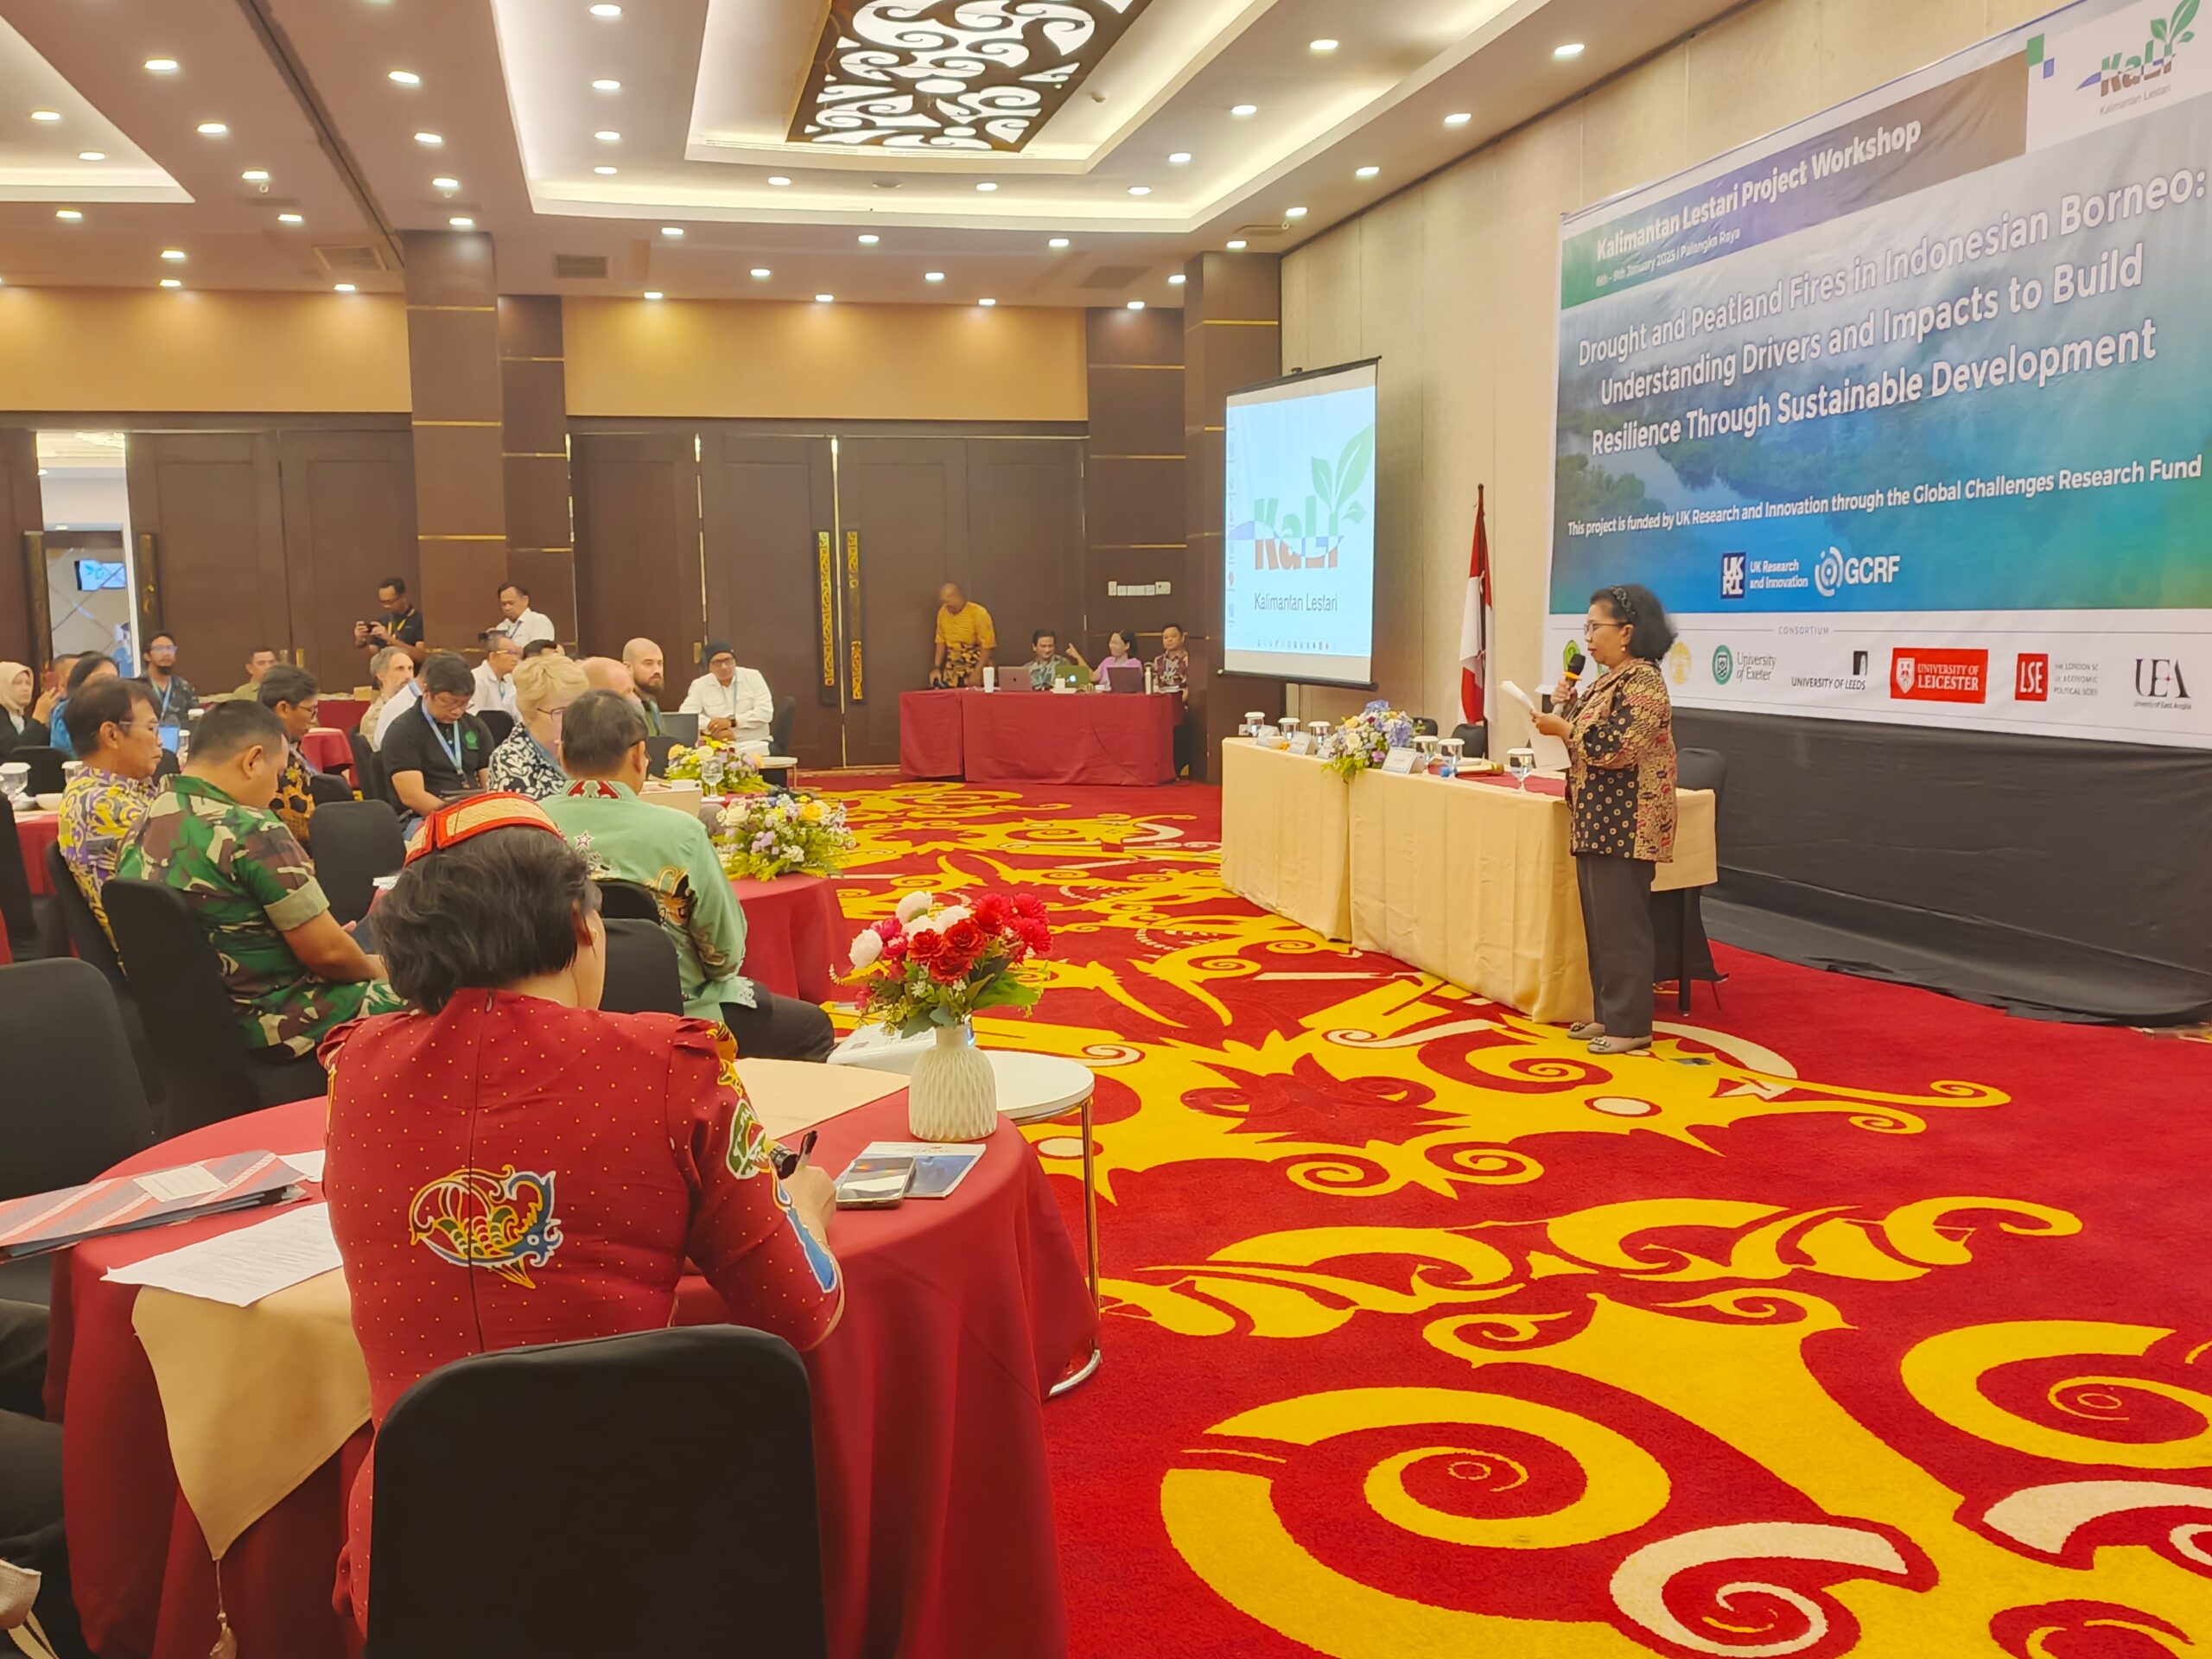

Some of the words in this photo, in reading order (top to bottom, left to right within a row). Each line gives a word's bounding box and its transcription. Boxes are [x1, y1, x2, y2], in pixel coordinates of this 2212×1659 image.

[1597, 213, 1680, 262] Kalimantan
[1683, 185, 1738, 229] Lestari
[1742, 161, 1808, 208] Project
[1812, 119, 1922, 180] Workshop
[1626, 258, 1656, 277] January
[1656, 252, 1675, 267] 2025
[1681, 235, 1718, 258] Palangka
[1719, 228, 1741, 245] Raya
[1579, 322, 1647, 367] Drought
[1651, 309, 1686, 347] and
[1691, 281, 1783, 337] Peatland
[1789, 270, 1847, 309] Fires
[1853, 257, 1877, 292] in
[1885, 212, 2049, 283] Indonesian
[2059, 169, 2206, 236] Borneo:
[1600, 353, 1737, 406] Understanding
[1742, 333, 1821, 374] Drivers
[1828, 311, 1875, 354] and
[1883, 286, 1999, 344] Impacts
[2008, 276, 2043, 314] to
[2053, 242, 2143, 304] Build
[1592, 416, 1681, 456] Resilience
[1686, 395, 1770, 440] Through
[1777, 366, 1923, 423] Sustainable
[1931, 318, 2158, 397] Development
[1567, 520, 1585, 537] This
[1586, 515, 1617, 537] project
[1618, 516, 1625, 531] is
[1627, 512, 1660, 530] funded
[1662, 511, 1675, 531] by
[1675, 510, 1691, 525] UK
[1692, 505, 1740, 524] Research
[1741, 502, 1763, 519] and
[1764, 495, 1828, 518] Innovation
[1831, 489, 1884, 512] through
[1887, 486, 1910, 507] the
[1913, 481, 1961, 505] Global
[1965, 474, 2055, 499] Challenges
[2058, 461, 2145, 490] Research
[2150, 454, 2202, 481] Fund
[1722, 556, 1745, 575] UK
[1750, 561, 1762, 573] UK
[1763, 559, 1800, 573] Research
[1844, 555, 1901, 585] GCRF
[1721, 574, 1744, 594] RI
[1750, 576, 1764, 589] and
[1765, 575, 1809, 588] Innovation
[1254, 593, 1304, 612] Kalimantan
[1306, 593, 1338, 612] Lestari
[1778, 626, 1829, 635] CONSORTIUM
[1736, 652, 1777, 669] University
[1917, 663, 1969, 675] UNIVERSITY
[1971, 664, 1980, 676] OF
[1736, 667, 1745, 681] of
[1745, 667, 1772, 681] Exeter
[1791, 677, 1834, 690] UNIVERSITY
[1834, 678, 1843, 689] OF
[1845, 679, 1866, 690] LEEDS
[1917, 675, 1980, 691] LEICESTER
[2019, 661, 2044, 694] LSE
[2134, 658, 2192, 698] UEA
